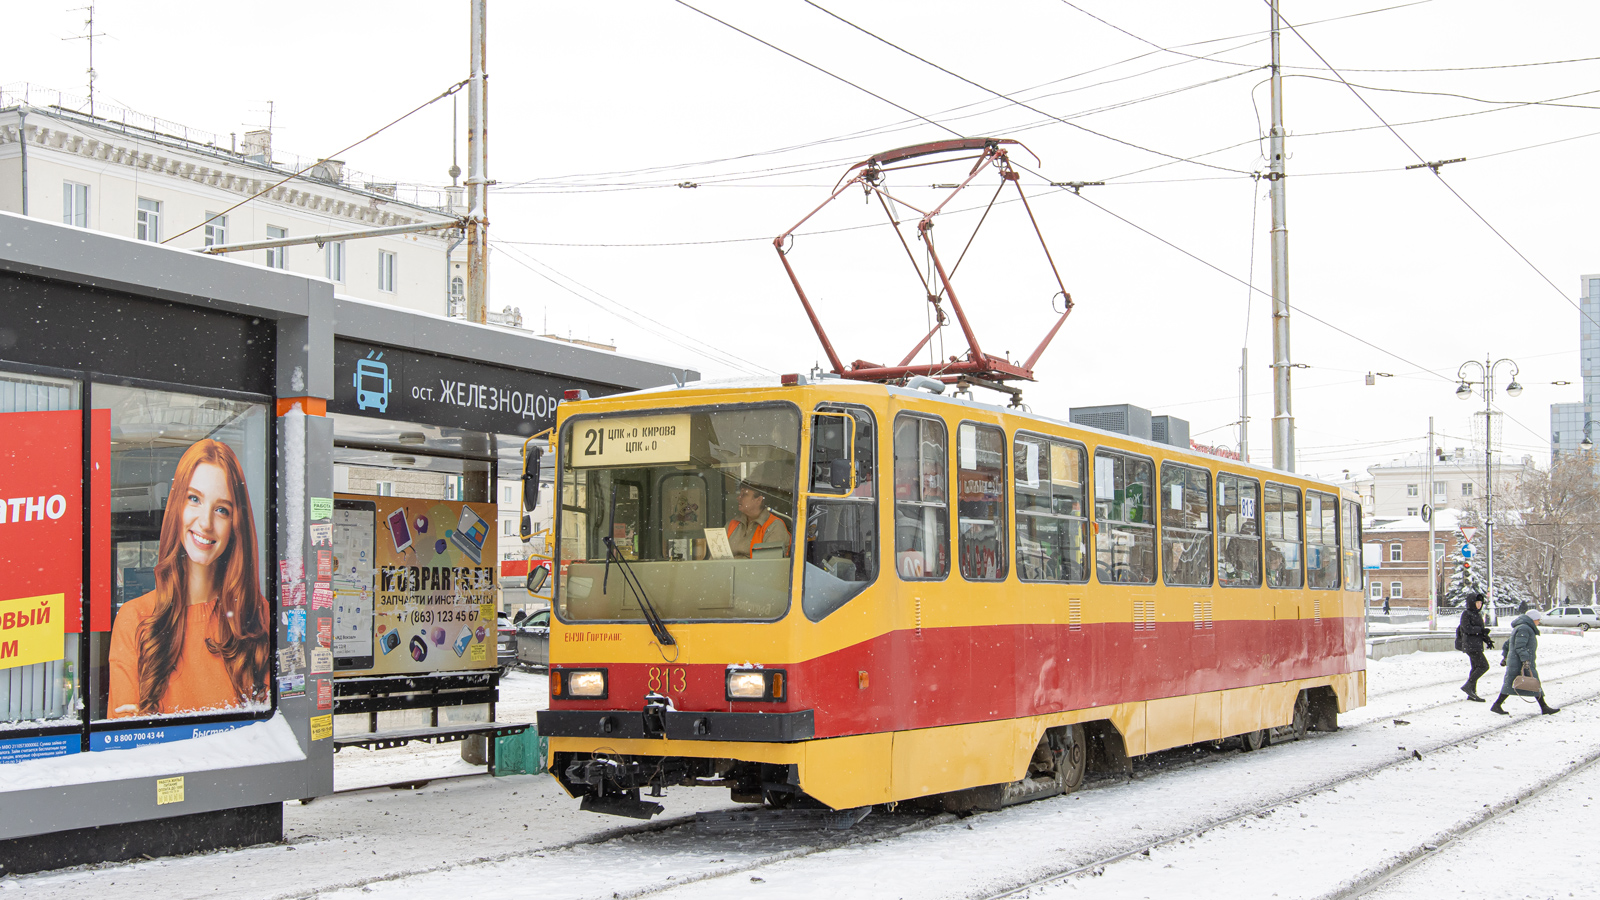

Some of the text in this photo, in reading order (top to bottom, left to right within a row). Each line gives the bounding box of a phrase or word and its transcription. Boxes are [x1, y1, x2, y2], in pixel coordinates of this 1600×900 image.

[411, 385, 436, 402] ост.
[584, 427, 604, 456] 21
[608, 428, 625, 441] ЦПК
[625, 441, 643, 453] ЦПК
[1241, 498, 1254, 517] 813
[0, 600, 51, 630] вый
[410, 610, 435, 625] (863)
[437, 610, 454, 622] 123
[455, 610, 467, 622] 45
[468, 610, 479, 622] 67
[648, 667, 687, 693] 813
[120, 734, 133, 742] 800
[133, 733, 146, 741] 700
[147, 732, 156, 740] 43
[155, 731, 165, 739] 44
